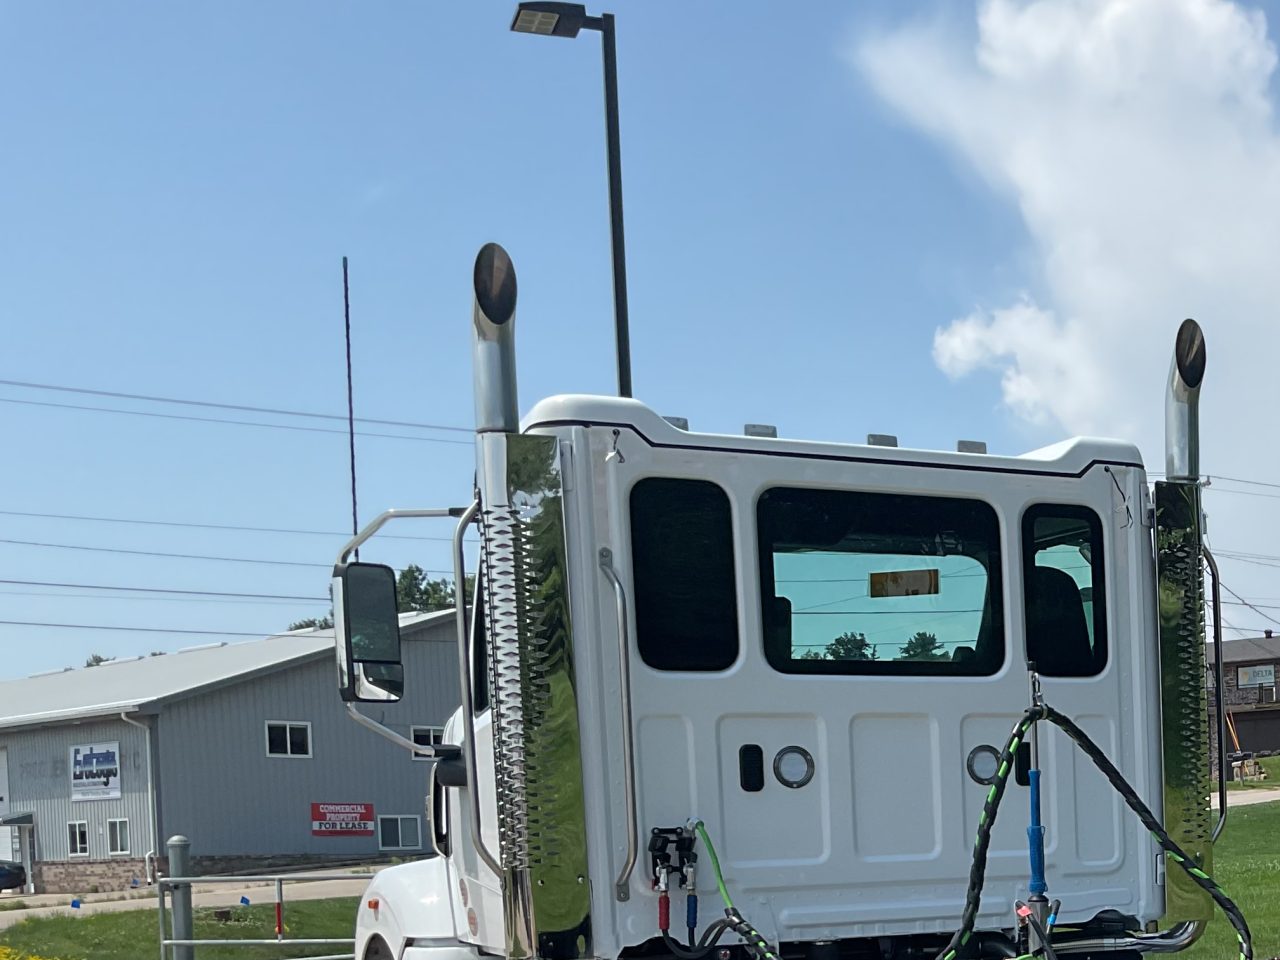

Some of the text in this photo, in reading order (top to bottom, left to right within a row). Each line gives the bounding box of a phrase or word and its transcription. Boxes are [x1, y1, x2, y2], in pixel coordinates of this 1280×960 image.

[319, 804, 366, 813] COMMERCIAL
[326, 813, 360, 821] PROPERTY
[339, 822, 368, 830] LEASE
